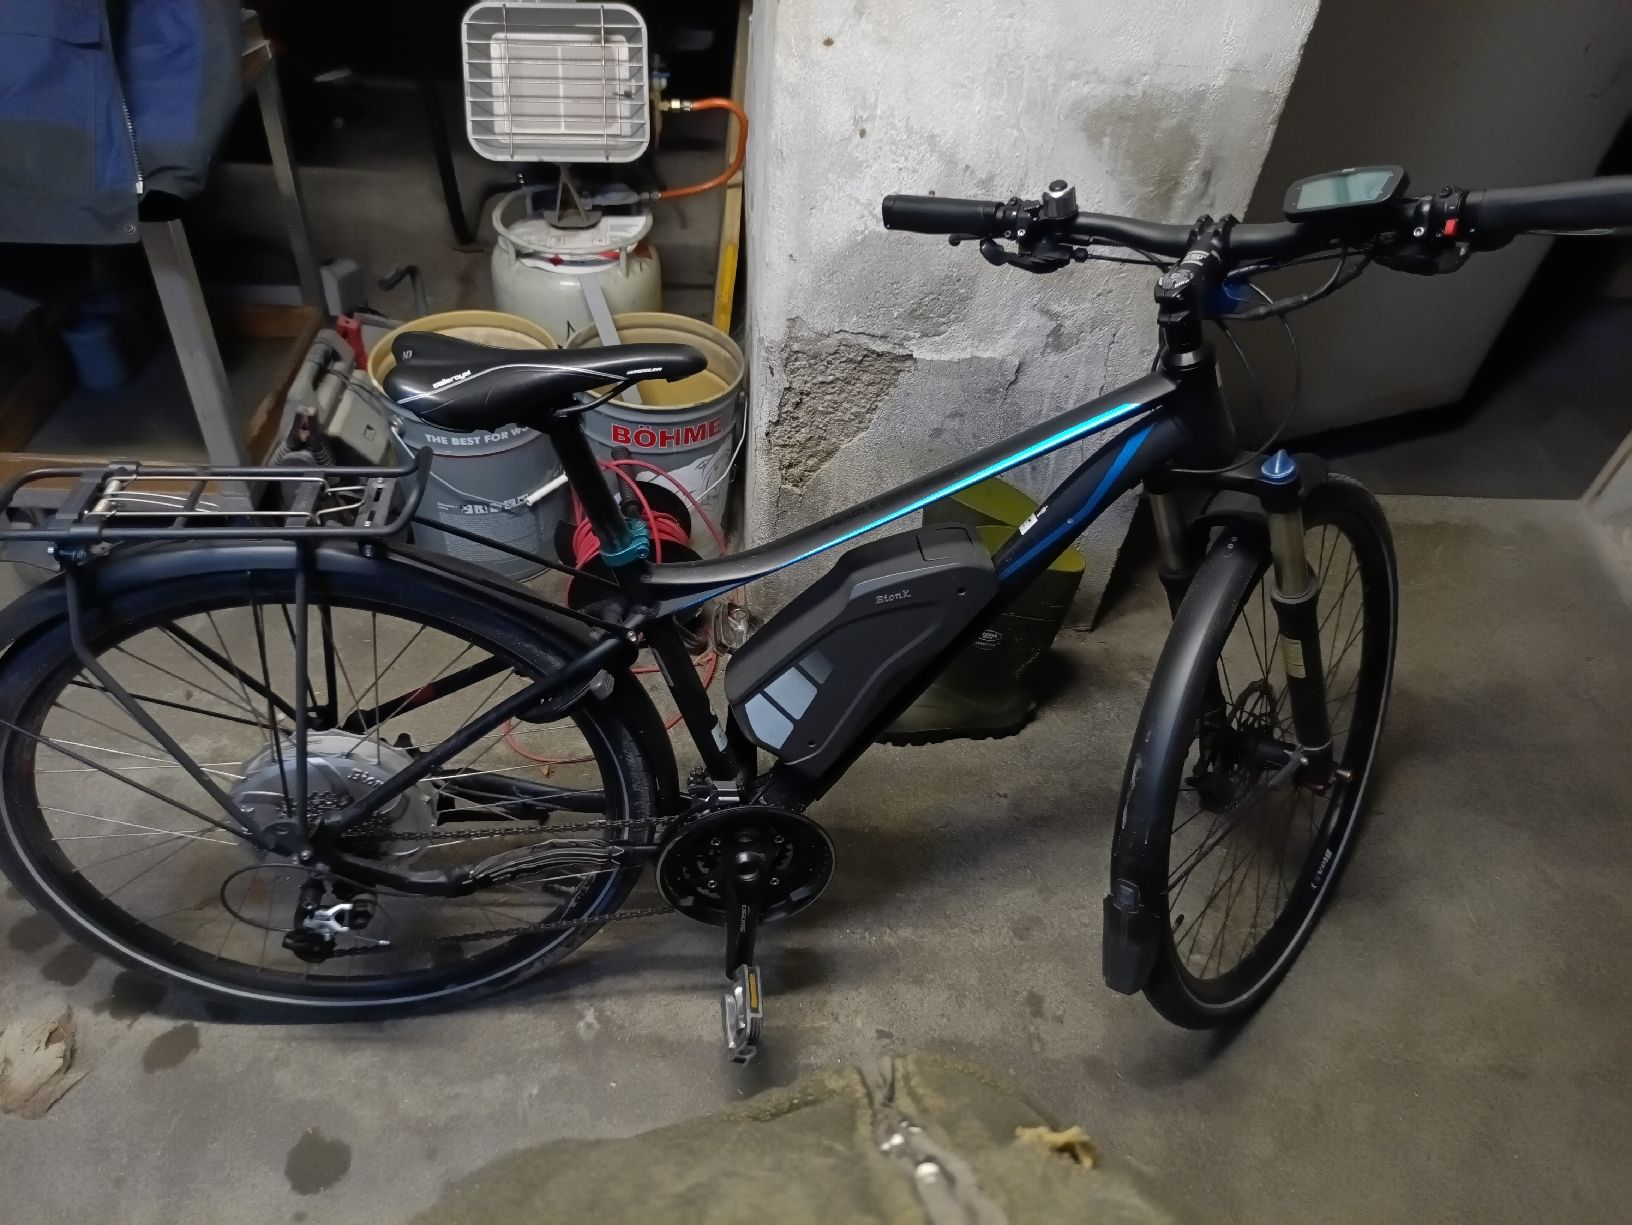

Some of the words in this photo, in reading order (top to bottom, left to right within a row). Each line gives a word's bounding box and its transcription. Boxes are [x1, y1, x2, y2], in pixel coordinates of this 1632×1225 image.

[424, 433, 449, 445] THE
[451, 436, 481, 446] BEST
[484, 431, 509, 443] FOR
[611, 414, 723, 449] BÖHME
